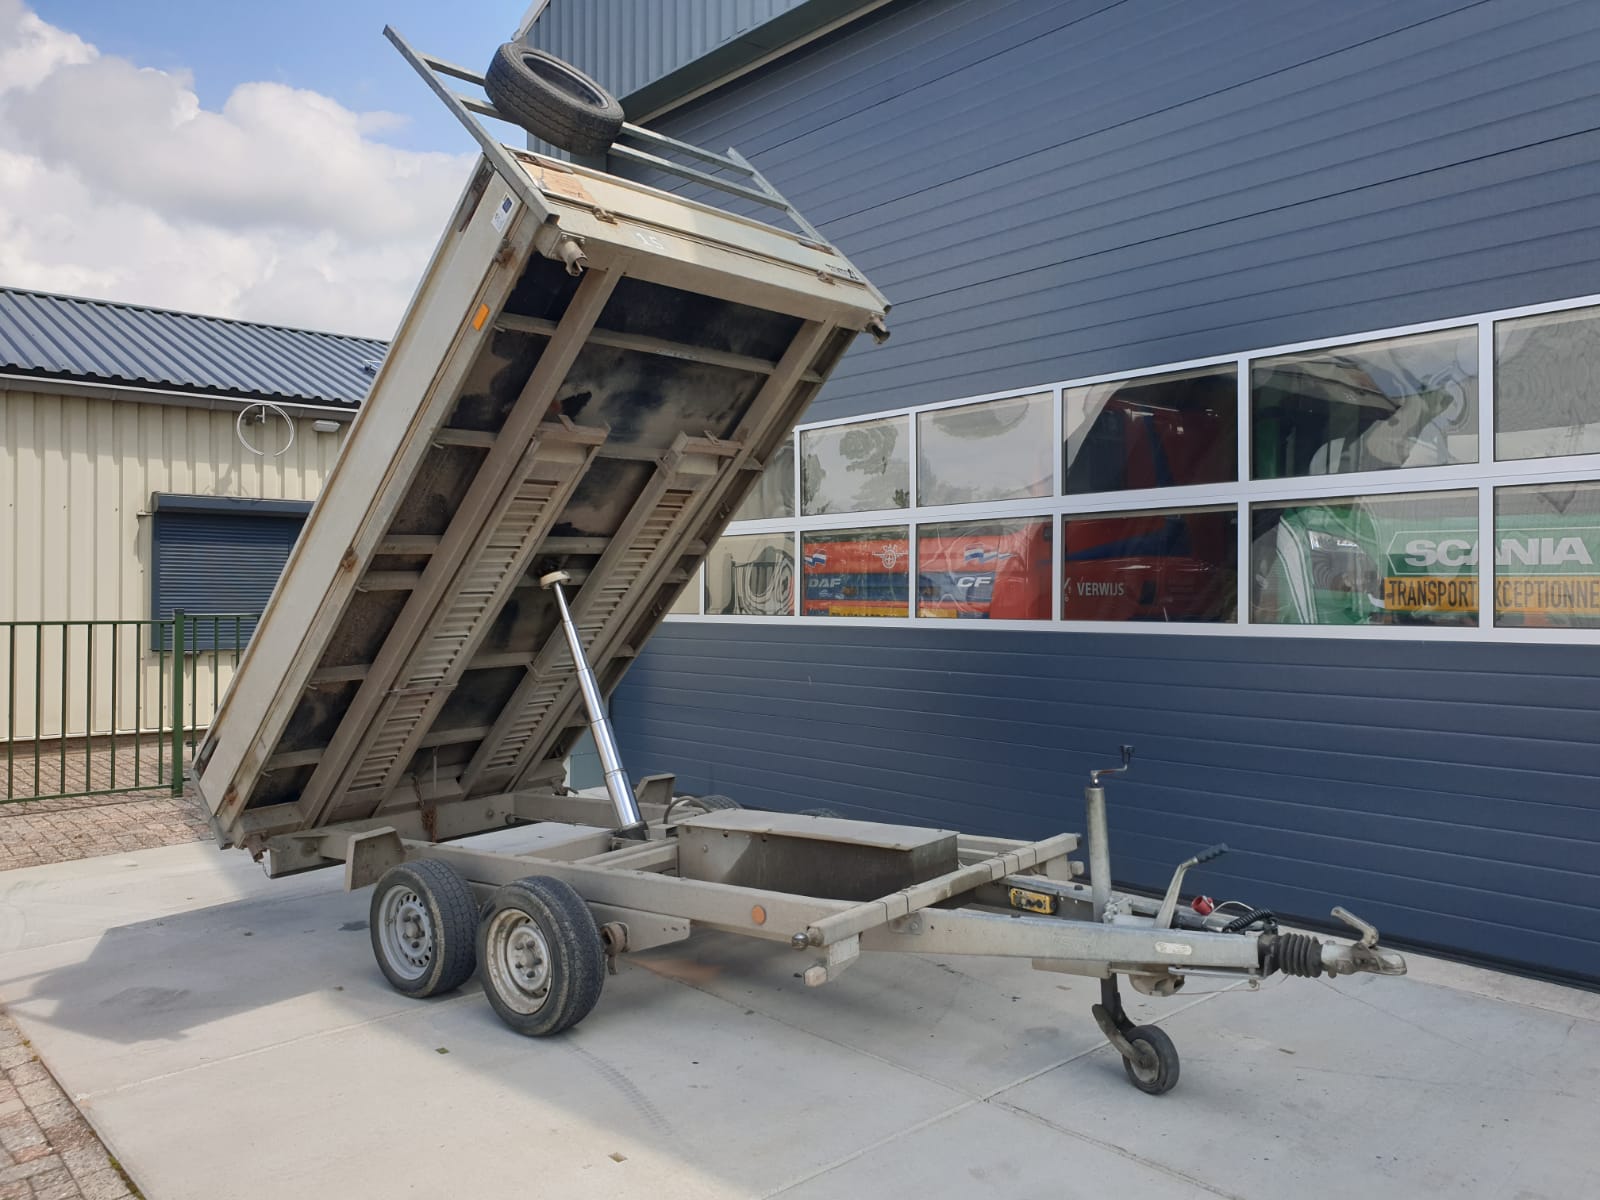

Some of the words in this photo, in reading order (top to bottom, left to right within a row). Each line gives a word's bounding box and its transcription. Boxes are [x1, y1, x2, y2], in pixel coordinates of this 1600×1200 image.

[808, 578, 841, 588] DAF
[957, 576, 992, 588] CF
[1076, 582, 1125, 597] VERWIJS
[1388, 580, 1477, 607] TRANSPORT
[1495, 580, 1600, 609] XCEPTIONNE
